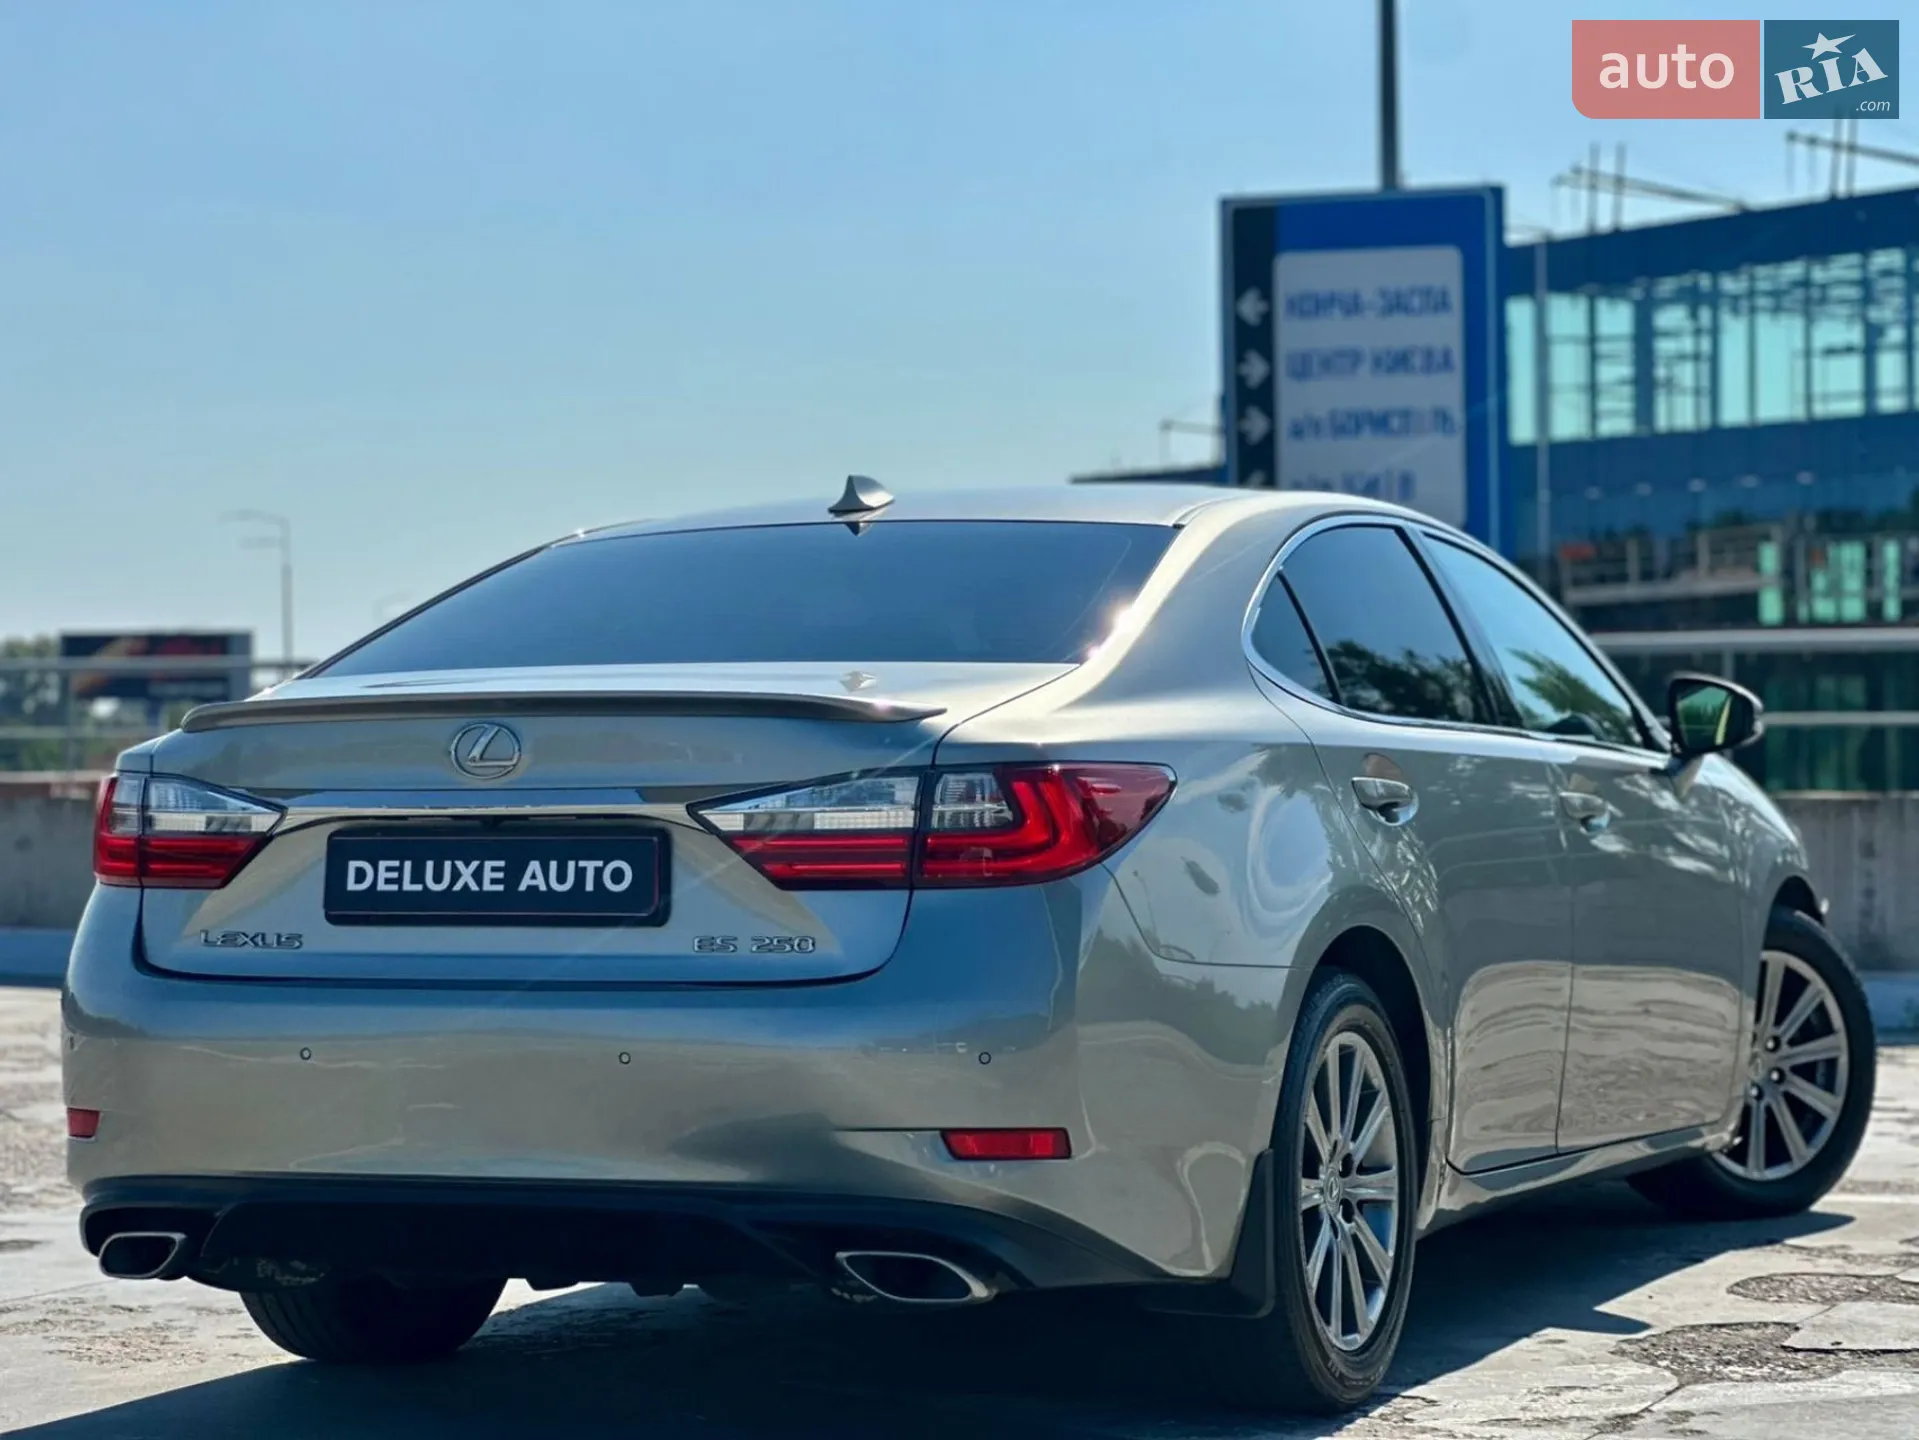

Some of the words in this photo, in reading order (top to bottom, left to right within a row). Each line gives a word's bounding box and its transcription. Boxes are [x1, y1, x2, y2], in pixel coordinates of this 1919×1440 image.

[346, 859, 506, 892] DELUXE
[517, 859, 633, 892] AUTO
[200, 929, 304, 950] LEXUS
[692, 935, 738, 954] ES
[749, 935, 816, 954] 250
